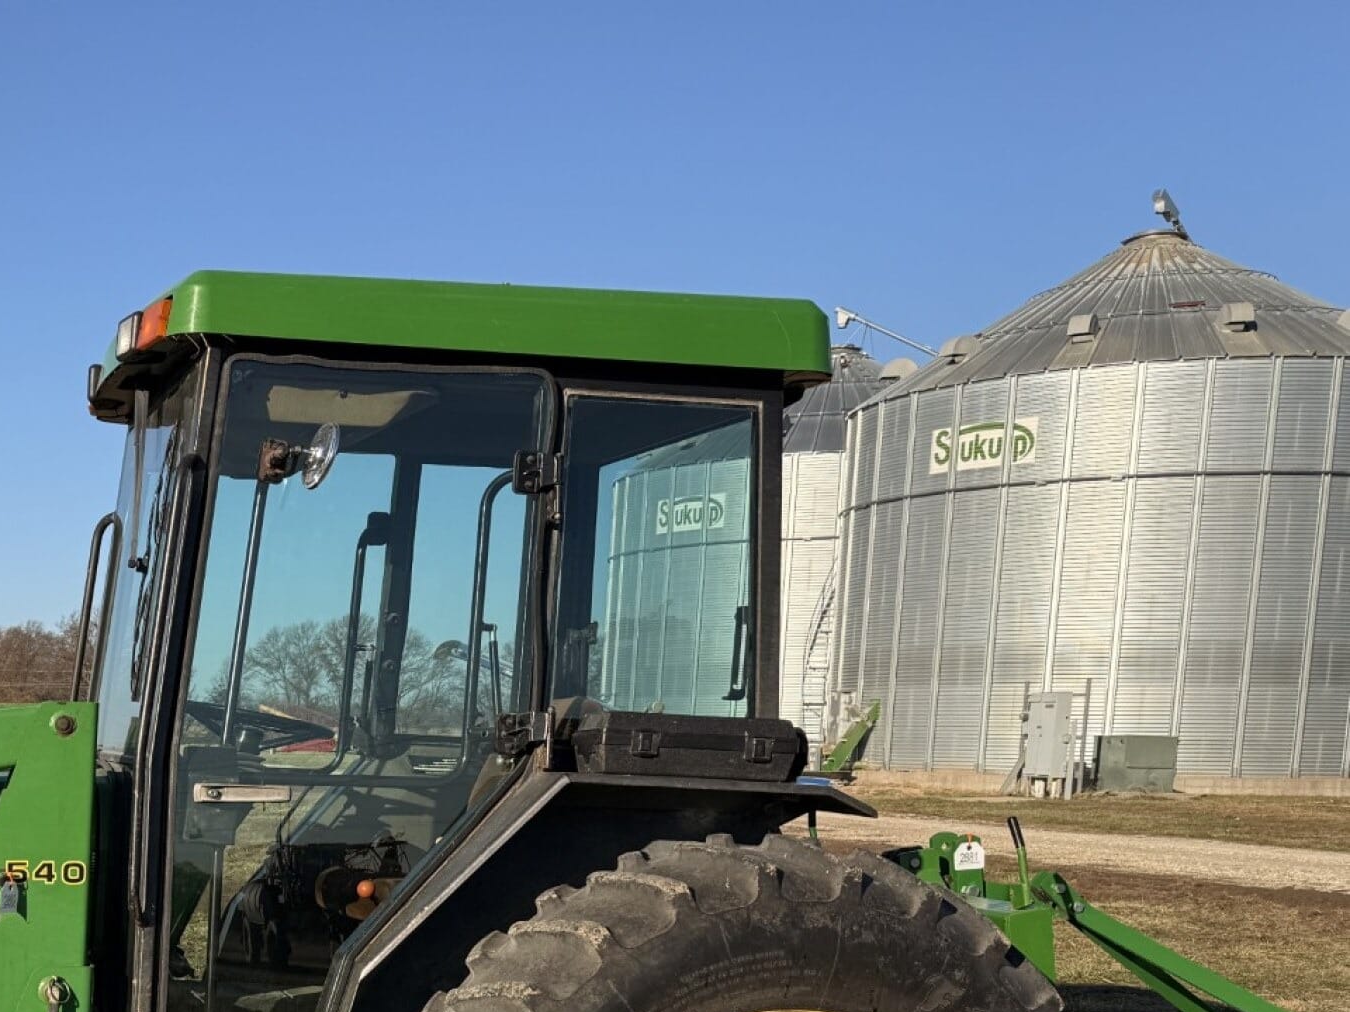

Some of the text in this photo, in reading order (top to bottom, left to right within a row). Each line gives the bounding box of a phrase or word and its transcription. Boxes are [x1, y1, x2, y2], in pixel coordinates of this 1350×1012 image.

[934, 424, 1035, 465] Sukup
[659, 497, 723, 528] Sukup
[5, 860, 86, 884] 540
